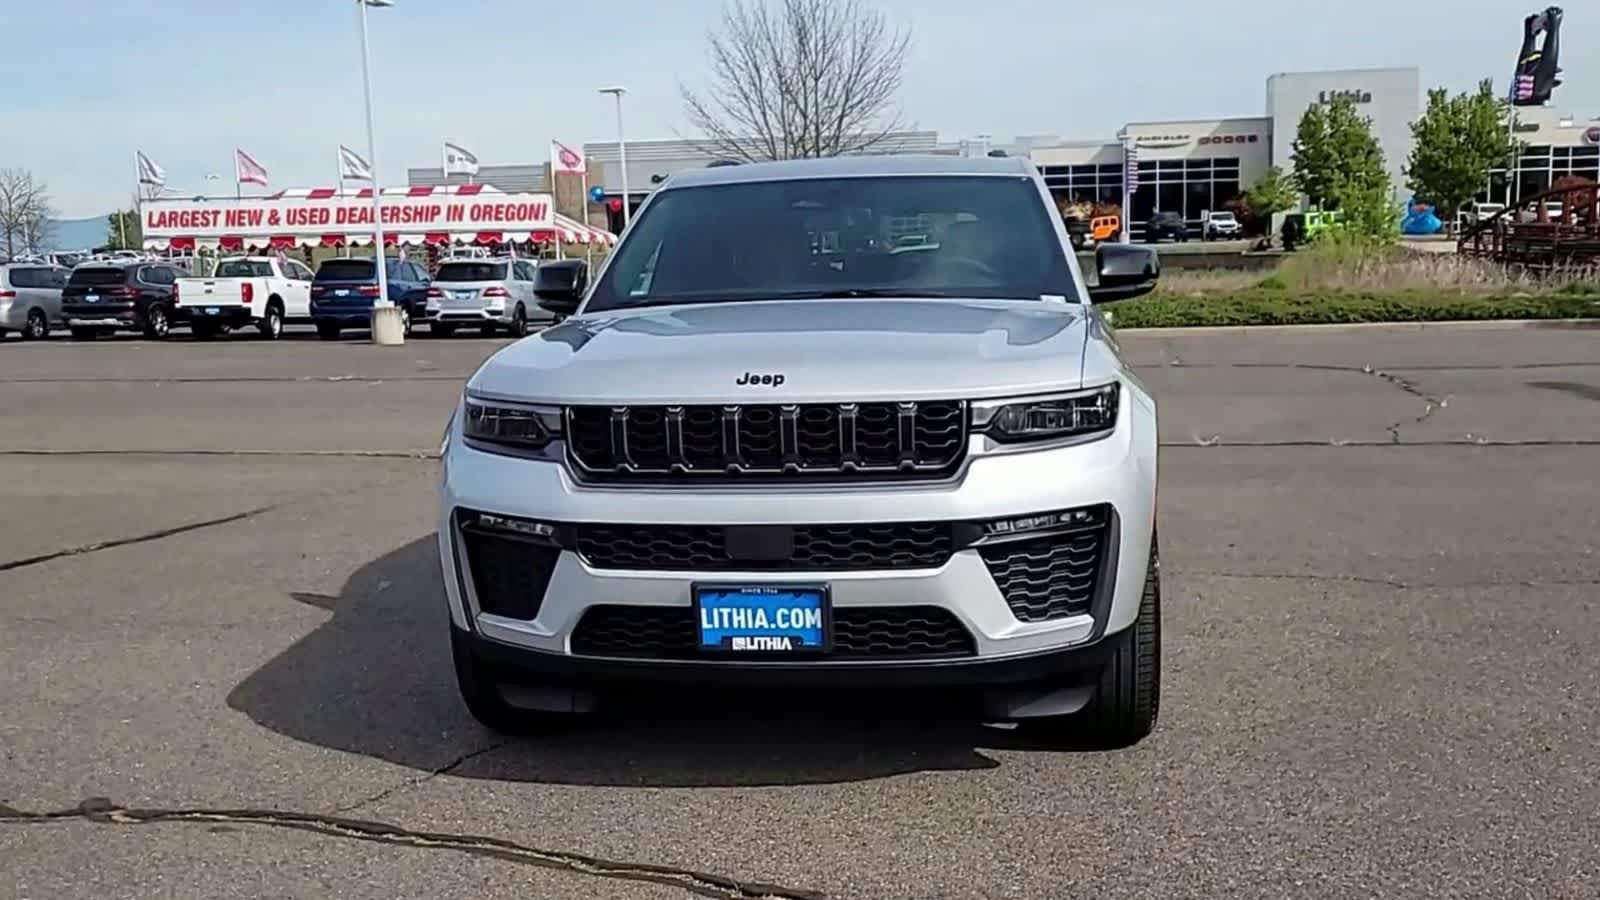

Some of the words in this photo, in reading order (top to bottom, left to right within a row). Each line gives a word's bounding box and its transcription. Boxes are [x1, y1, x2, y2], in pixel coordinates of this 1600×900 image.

[147, 209, 221, 228] LARGEST
[225, 208, 264, 227] NEW
[268, 208, 280, 226] &
[286, 207, 330, 226] USED
[335, 205, 441, 224] DEALERSHIP
[446, 204, 465, 222] IN
[470, 203, 547, 221] OREGON!
[736, 371, 785, 387] Jeep
[701, 608, 822, 629] LITHIA.COM
[747, 637, 792, 650] LITHIA
